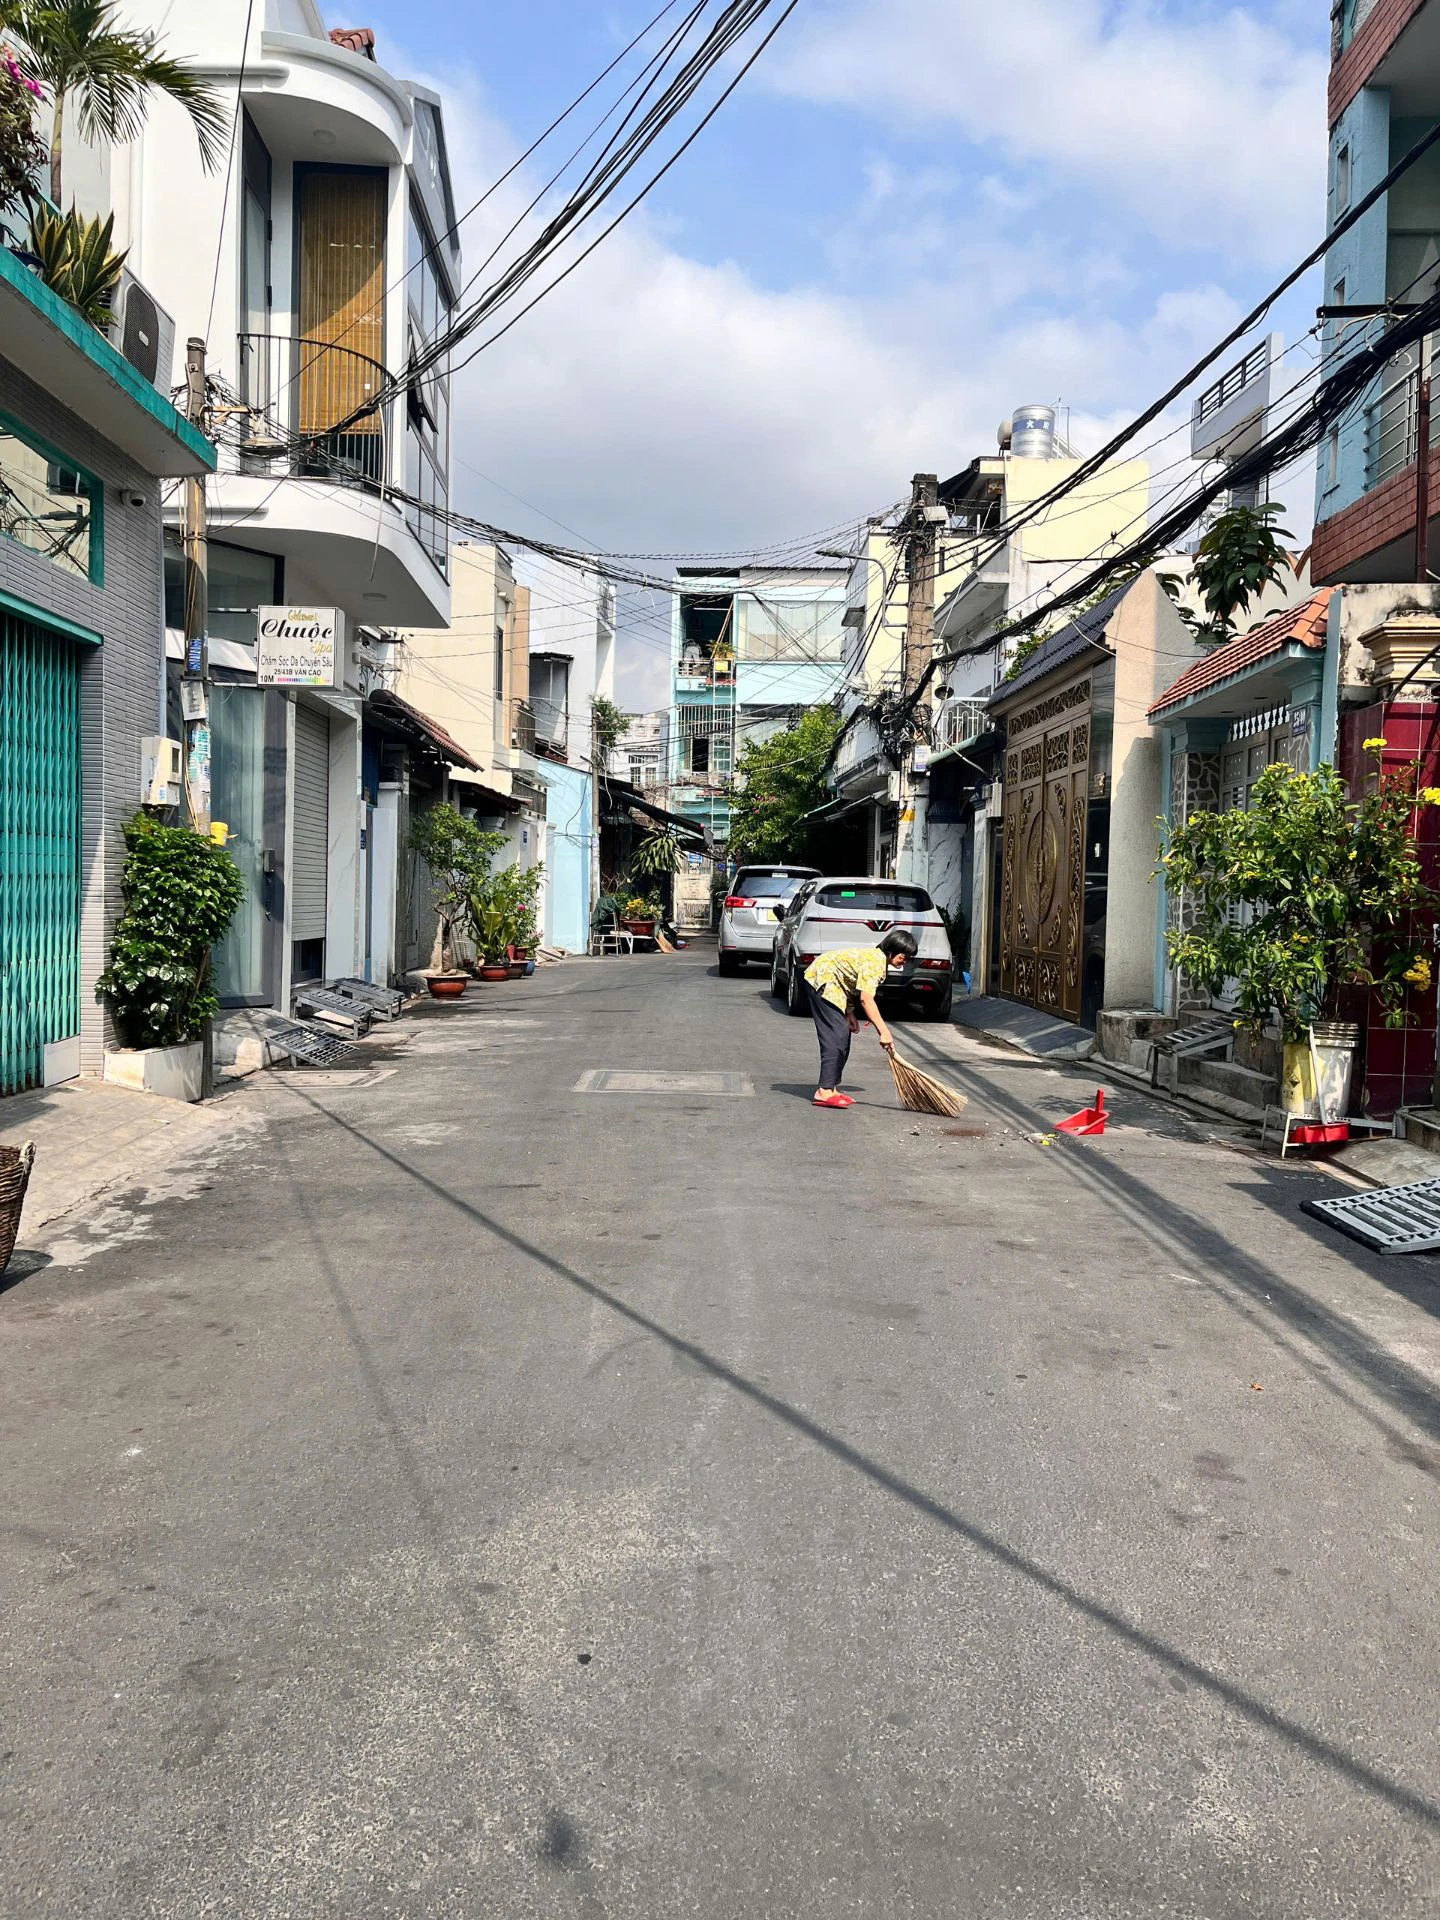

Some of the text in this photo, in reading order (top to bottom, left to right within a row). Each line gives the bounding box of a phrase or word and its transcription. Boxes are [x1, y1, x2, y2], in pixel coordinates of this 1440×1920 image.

[261, 619, 333, 642] Chuộc
[290, 655, 299, 666] Da
[308, 669, 322, 677] CAO
